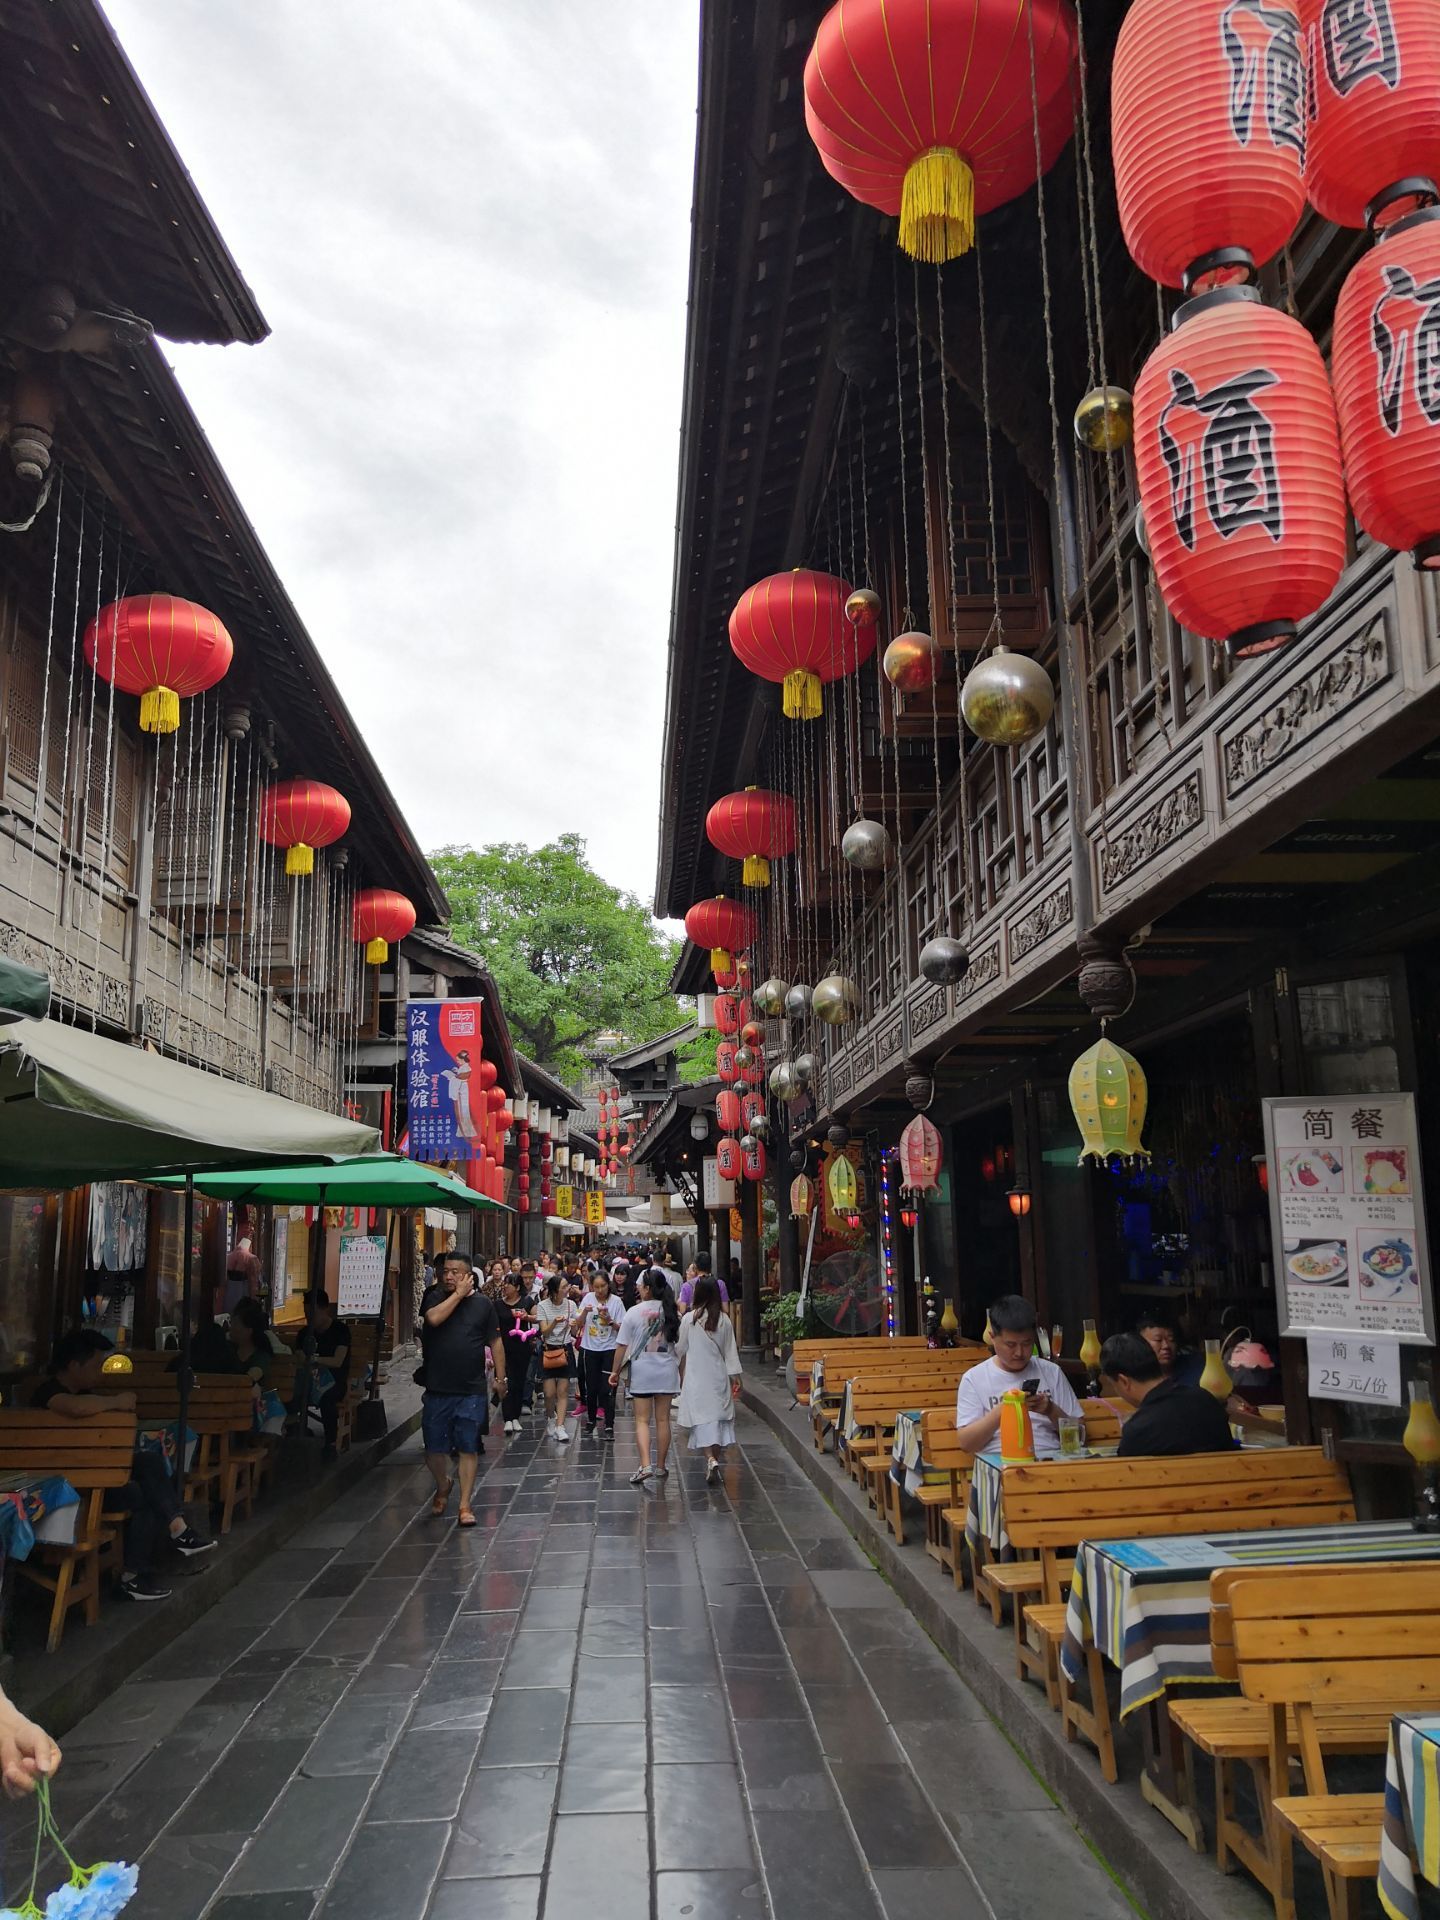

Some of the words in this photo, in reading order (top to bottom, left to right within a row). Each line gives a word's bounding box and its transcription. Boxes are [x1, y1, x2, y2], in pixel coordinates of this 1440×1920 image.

[1158, 367, 1284, 552] 酒
[410, 1008, 430, 1108] 汉服体验馆
[1302, 1107, 1385, 1140] 简餐
[1331, 1341, 1376, 1363] 简餐
